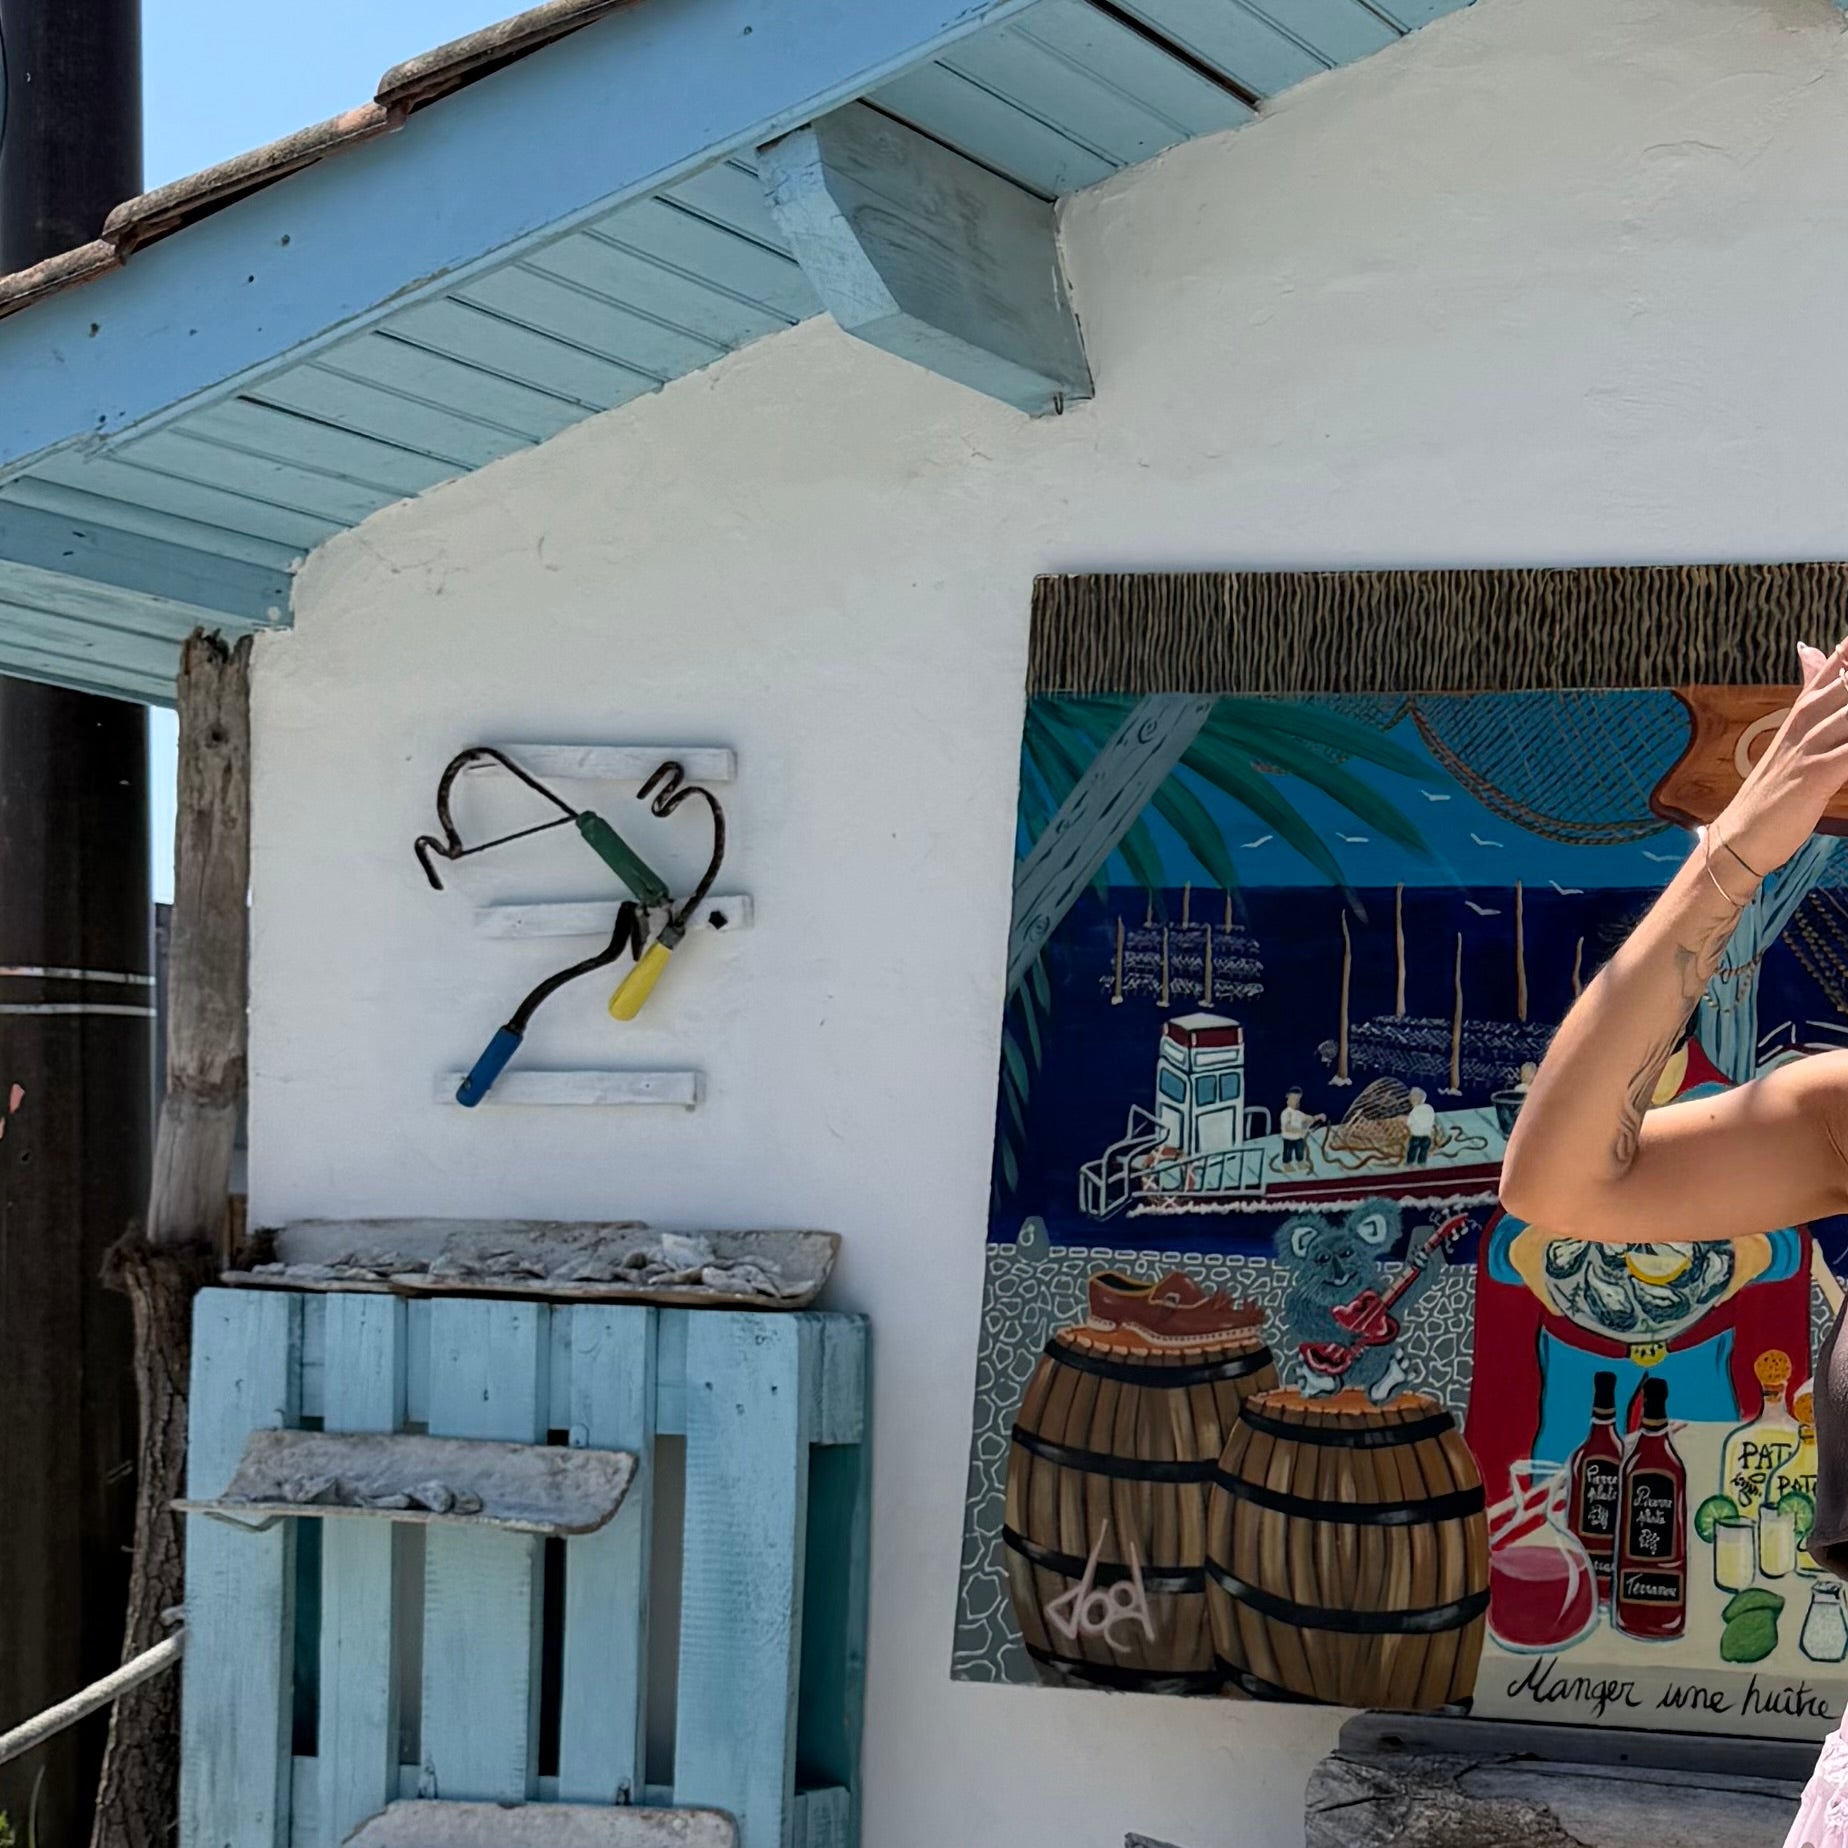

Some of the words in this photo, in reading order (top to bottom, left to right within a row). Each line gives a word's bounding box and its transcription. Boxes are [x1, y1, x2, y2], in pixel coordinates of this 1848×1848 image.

[1738, 1441, 1793, 1470] PAT
[1507, 1656, 1643, 1719] Manger
[1656, 1682, 1735, 1714] une
